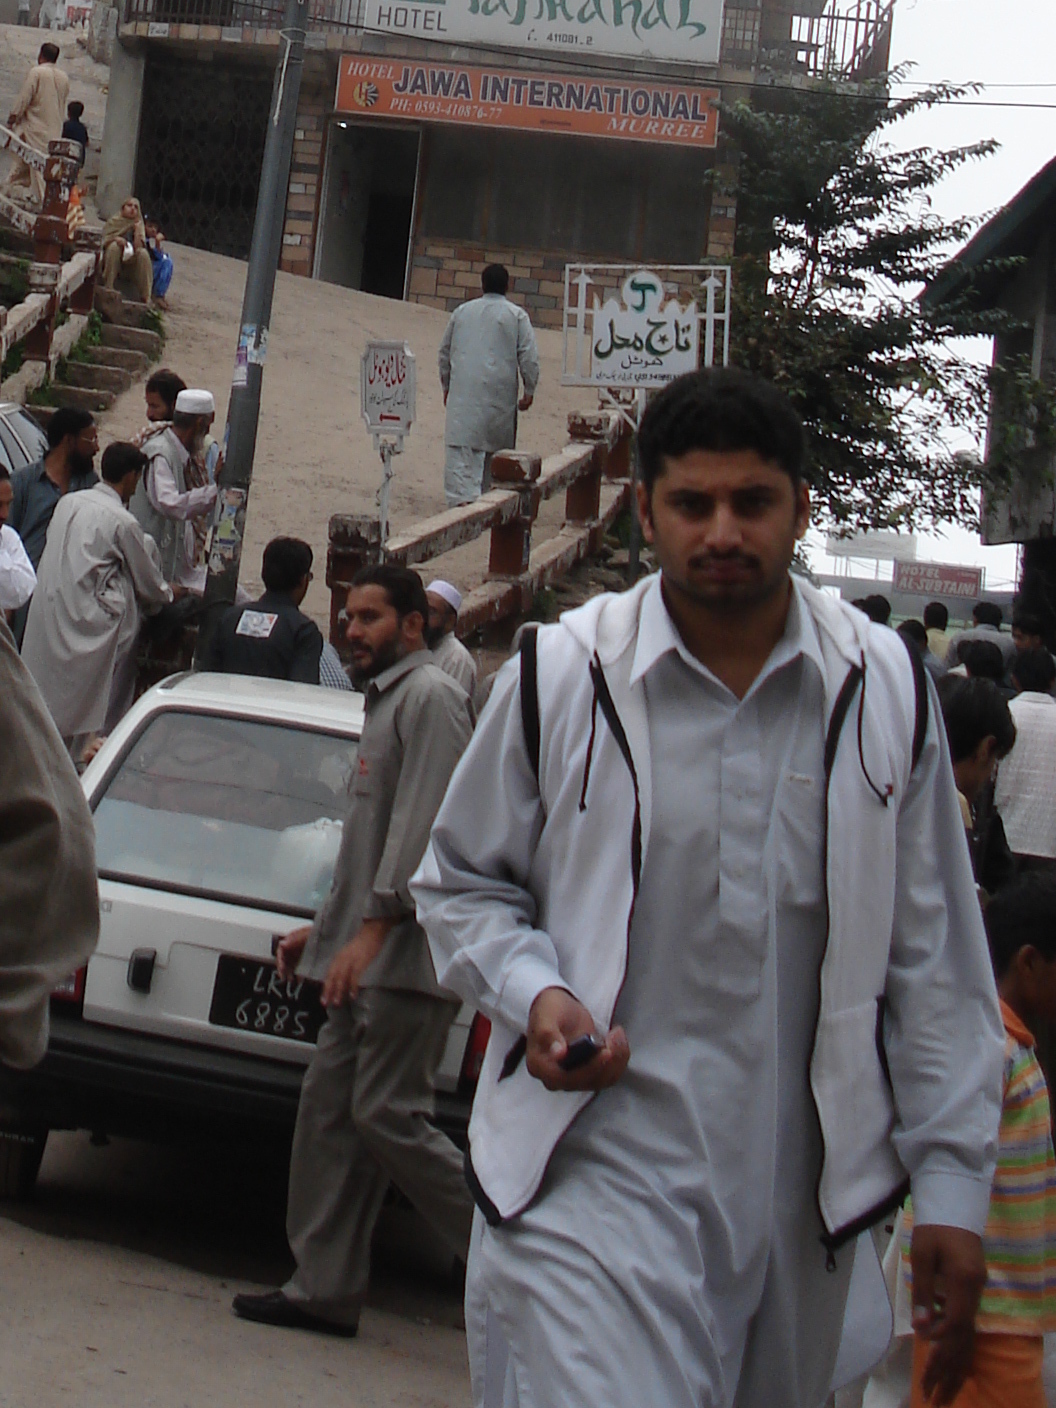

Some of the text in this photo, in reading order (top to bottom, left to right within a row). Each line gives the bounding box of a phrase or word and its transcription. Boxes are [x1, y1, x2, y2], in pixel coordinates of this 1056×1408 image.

[377, 5, 447, 32] HOTEL
[347, 62, 707, 124] HOTEL JAWA INTERNATIONAL
[607, 116, 707, 139] MURREE
[900, 563, 940, 579] HOTEL
[235, 998, 309, 1036] 6885
